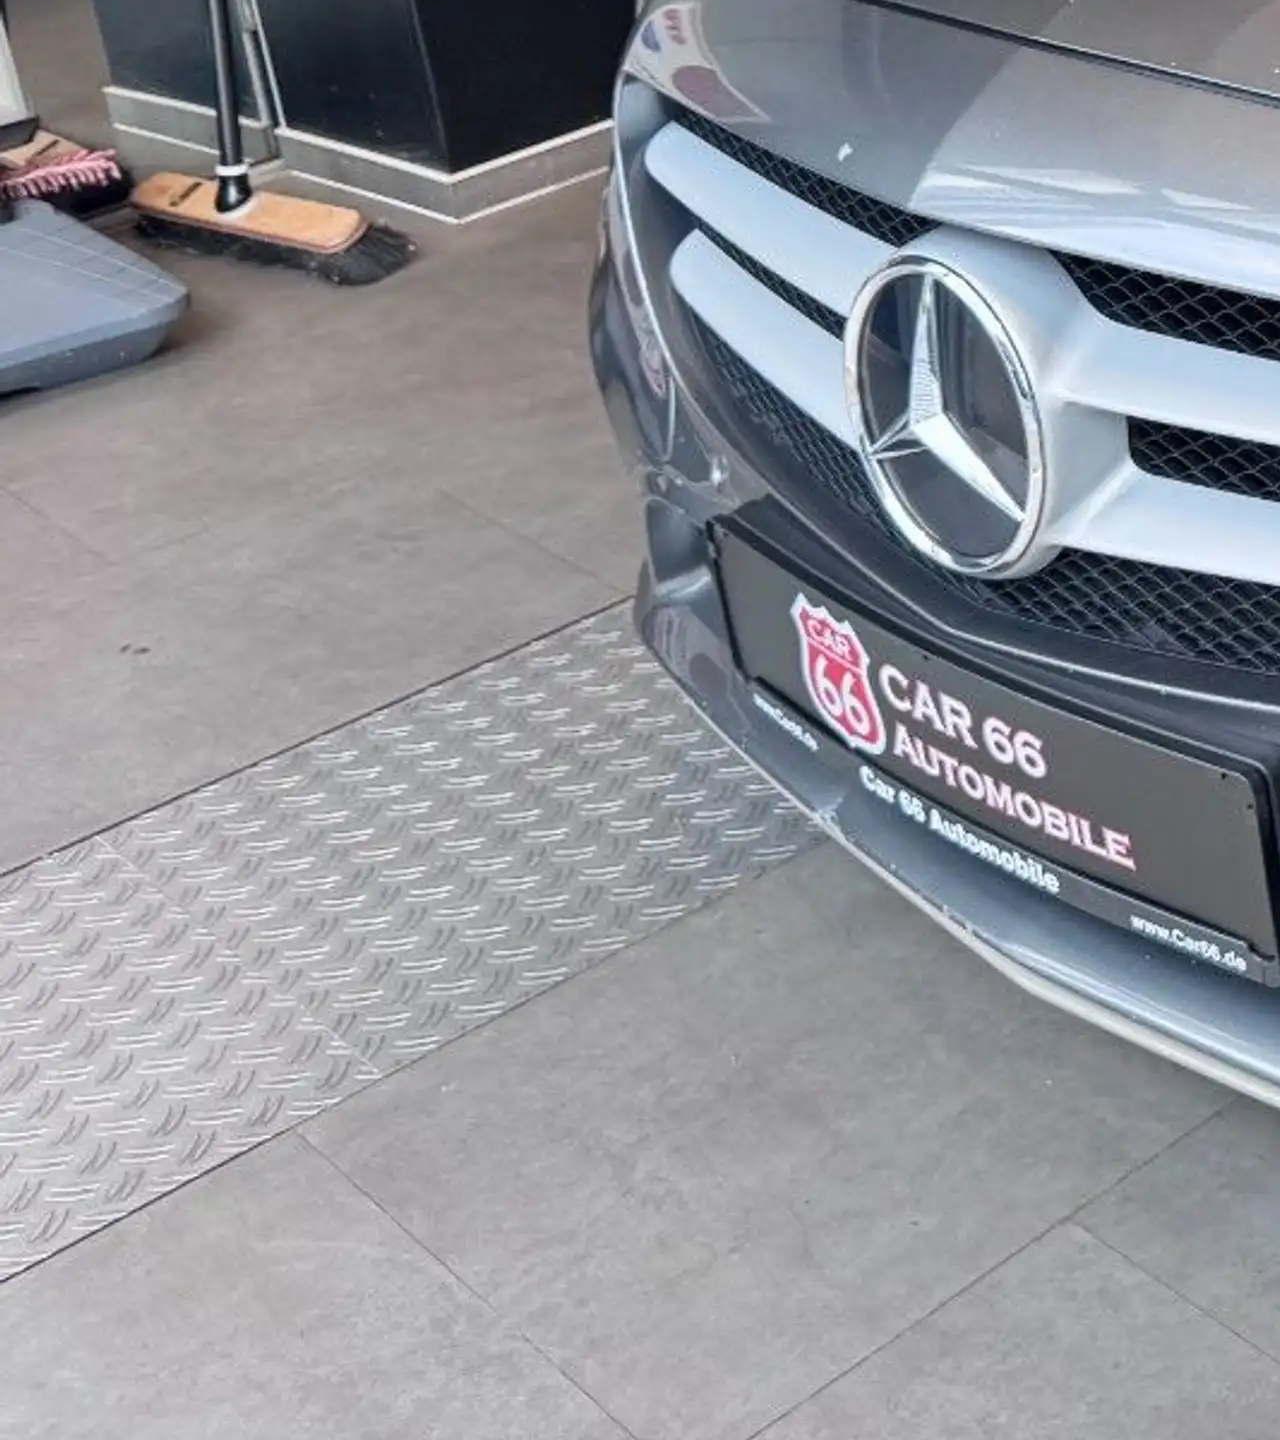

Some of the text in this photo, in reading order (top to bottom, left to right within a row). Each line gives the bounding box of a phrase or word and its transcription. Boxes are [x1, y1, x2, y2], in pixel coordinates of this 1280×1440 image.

[806, 618, 854, 662] CAR
[815, 652, 871, 736] 66
[878, 663, 1048, 779] CAR 66
[858, 764, 897, 805] Car
[928, 808, 1062, 896] Automobile
[893, 720, 1138, 872] AUTOMOBILE
